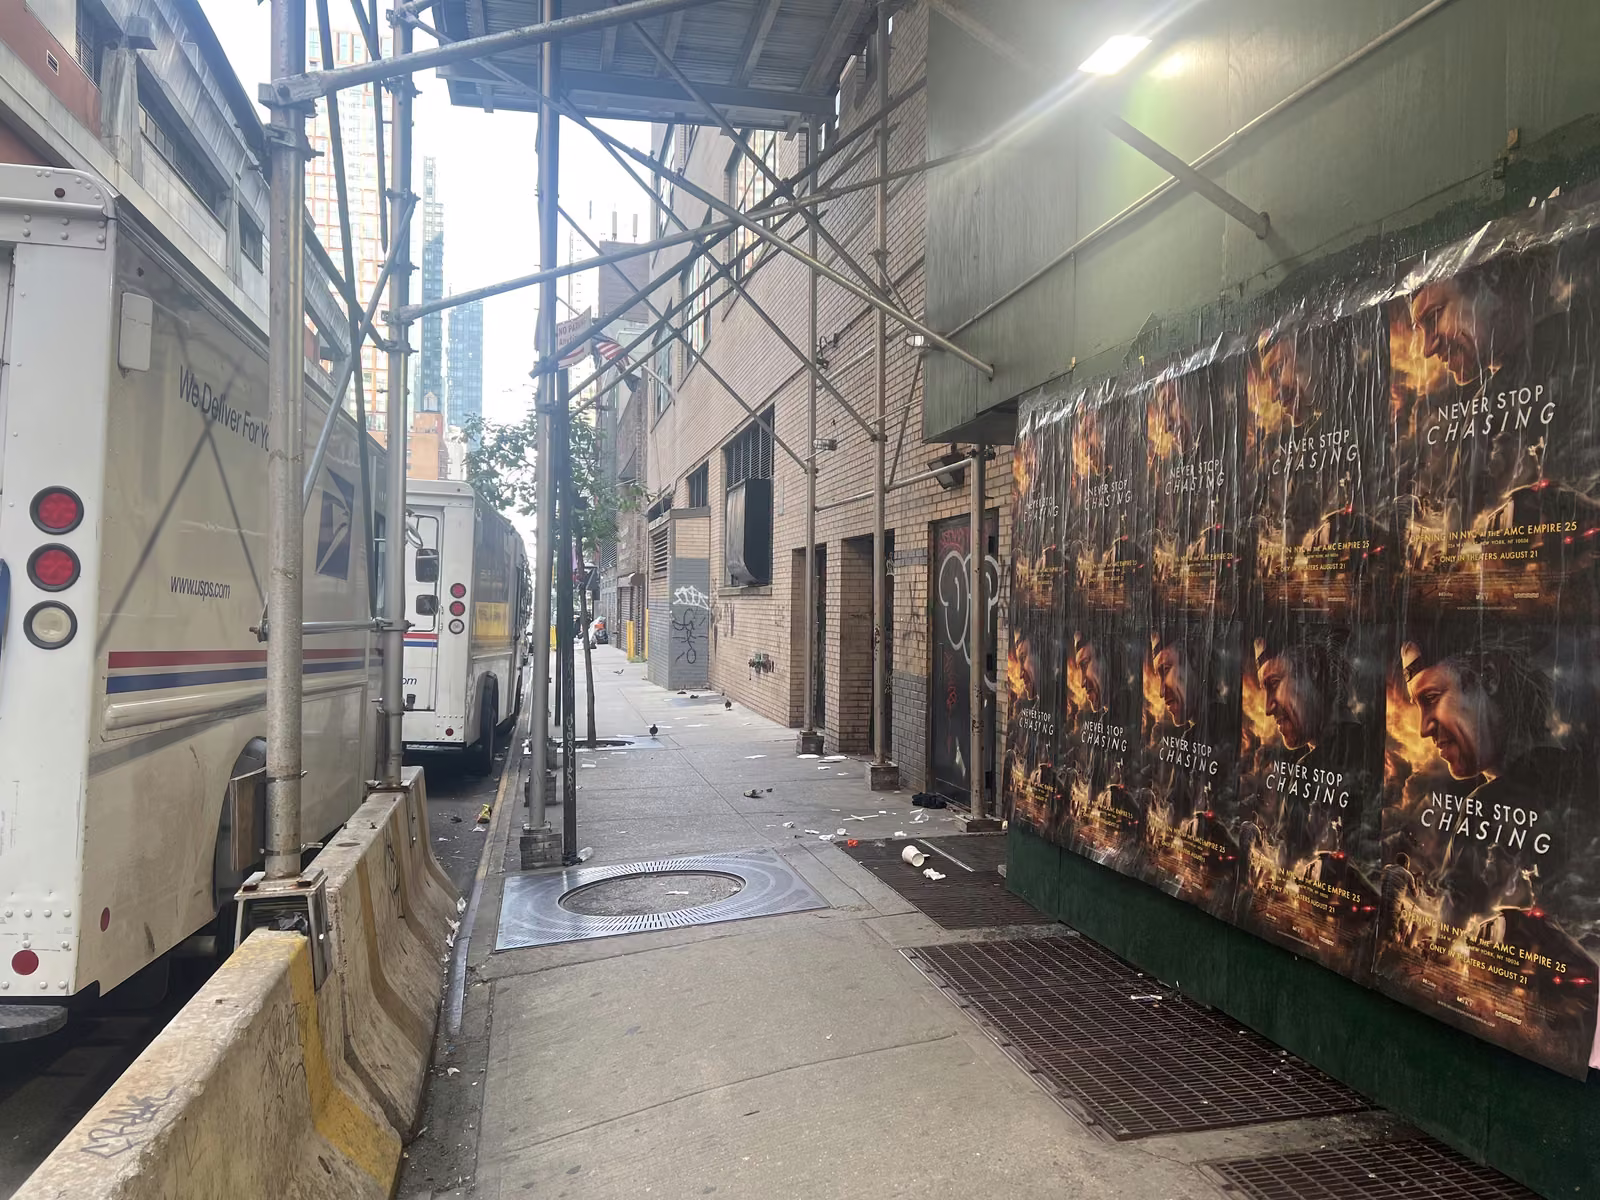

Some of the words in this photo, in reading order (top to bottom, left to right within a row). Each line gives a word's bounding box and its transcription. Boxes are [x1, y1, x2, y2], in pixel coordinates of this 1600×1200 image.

[180, 364, 200, 408] We
[201, 382, 242, 434] Deliver
[242, 410, 260, 444] For
[1438, 397, 1489, 422] NEVER
[1497, 384, 1544, 410] STOP
[1427, 402, 1556, 445] CHASING
[1279, 437, 1315, 455] NEVER
[1320, 429, 1350, 447] STOP
[1199, 459, 1219, 474] STOP
[1272, 444, 1358, 475] CHASING
[1165, 472, 1225, 495] CHASING
[1084, 490, 1131, 510] CHASING
[1449, 531, 1458, 540] IN
[1504, 526, 1525, 536] AMC
[1528, 523, 1562, 534] EMPIRE
[1565, 521, 1577, 532] 25
[1322, 543, 1337, 552] AMC
[1338, 540, 1361, 550] EMPIRE
[1362, 540, 1370, 549] 25
[1500, 551, 1528, 560] AUGUST
[1530, 550, 1538, 558] 21
[170, 576, 231, 602] www.usps.com
[1084, 720, 1104, 734] NEVER
[1107, 724, 1124, 736] STOP
[1081, 731, 1127, 752] CHASING
[1162, 736, 1188, 751] NEVER
[1192, 741, 1212, 757] STOP
[1159, 747, 1218, 775] CHASING
[1273, 760, 1308, 780] NEVER
[1313, 768, 1343, 787] STOP
[1266, 774, 1350, 808] CHASING
[1432, 791, 1483, 818] NEVER
[1493, 804, 1538, 828] STOP
[1421, 808, 1551, 854] CHASING
[1313, 880, 1326, 891] AMC
[1328, 885, 1350, 900] EMPIRE
[1352, 893, 1360, 903] 25
[1401, 909, 1437, 929] OPENING
[1440, 923, 1450, 933] IN
[1493, 942, 1515, 956] AMC
[1519, 949, 1552, 969] EMPIRE
[1555, 962, 1567, 974] 25
[1430, 943, 1446, 955] ONLY
[1488, 965, 1518, 981] AUGUST
[1519, 975, 1527, 985] 21
